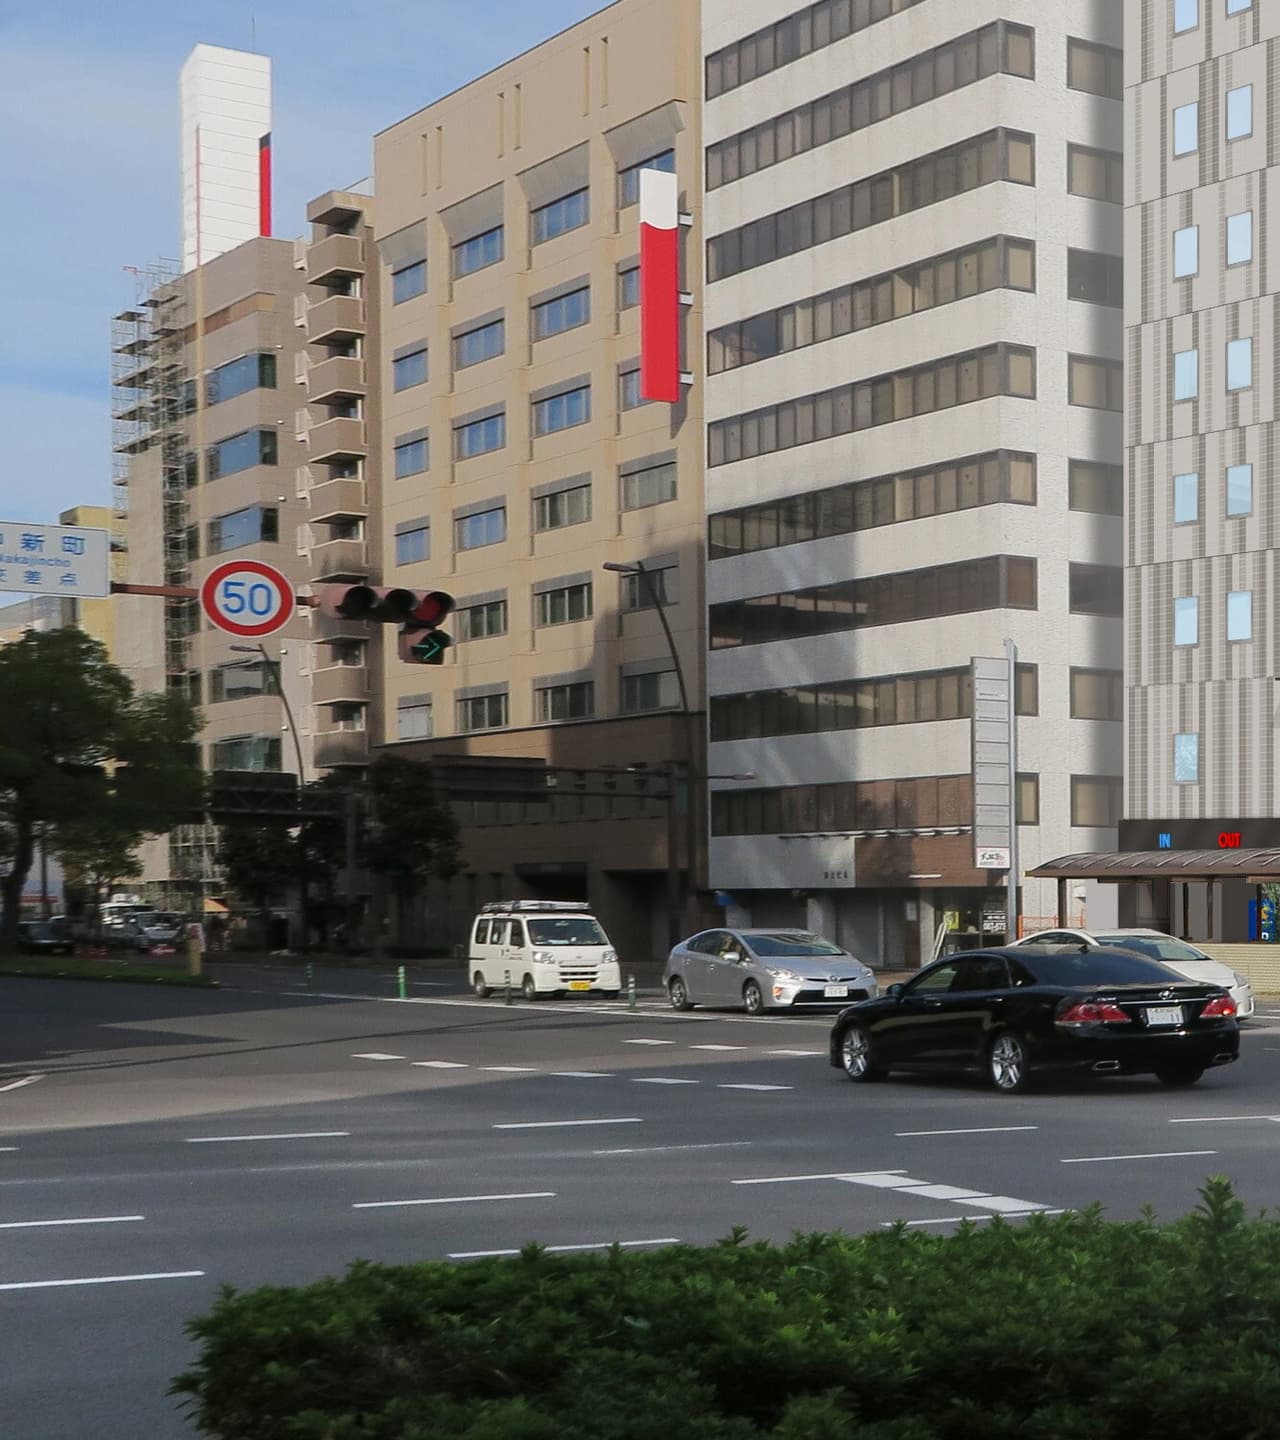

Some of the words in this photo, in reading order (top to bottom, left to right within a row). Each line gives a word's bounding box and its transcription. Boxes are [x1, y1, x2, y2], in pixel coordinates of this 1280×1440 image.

[0, 533, 86, 555] 新町
[222, 581, 272, 616] 50
[1159, 833, 1171, 849] IN
[1218, 832, 1242, 849] OUT
